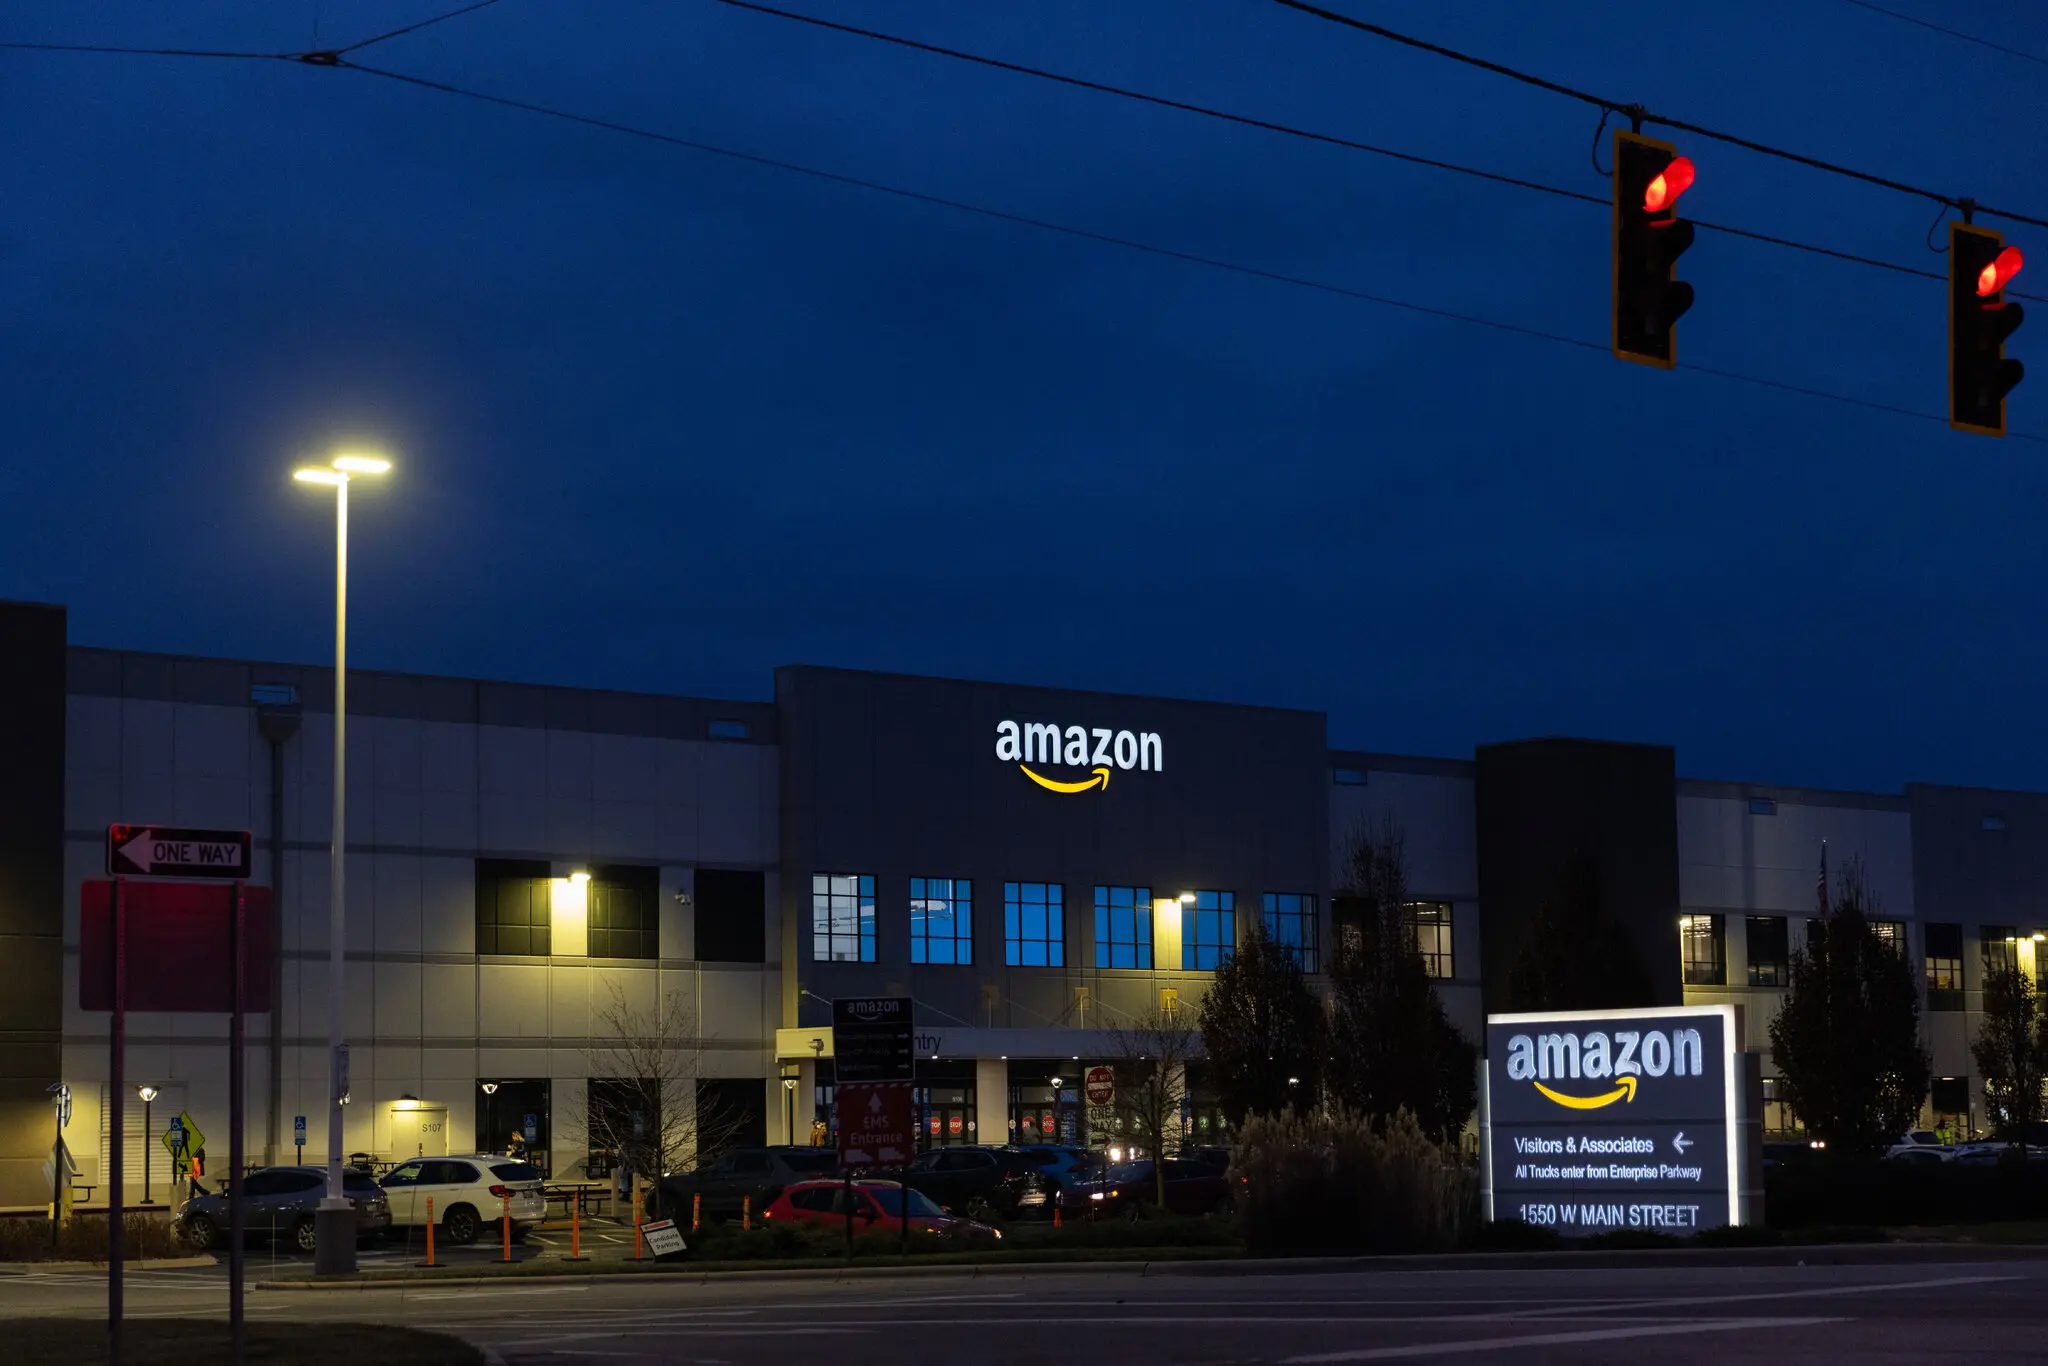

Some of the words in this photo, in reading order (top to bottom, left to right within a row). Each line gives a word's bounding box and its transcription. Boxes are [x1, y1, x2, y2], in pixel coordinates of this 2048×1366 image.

[995, 719, 1163, 772] amazon
[154, 842, 191, 862] ONE
[199, 843, 236, 864] WAY
[847, 1000, 899, 1014] amazon
[914, 1032, 942, 1055] ntry
[1507, 1028, 1702, 1080] amazon
[1091, 1107, 1111, 1119] ONE
[422, 1123, 441, 1133] S107
[863, 1115, 890, 1130] EMS
[850, 1131, 903, 1146] Entrance
[1514, 1136, 1563, 1154] Visitors
[1566, 1137, 1577, 1154] &
[1580, 1136, 1654, 1154] Associates
[1515, 1164, 1527, 1178] All
[1529, 1164, 1560, 1179] Trucks
[1561, 1166, 1585, 1179] enter
[1587, 1164, 1608, 1179] from
[1610, 1164, 1658, 1182] Enterprise
[1660, 1164, 1702, 1182] Parkway
[1519, 1204, 1556, 1225] 1550
[1560, 1205, 1577, 1225] W
[1580, 1205, 1624, 1226] MAIN
[1628, 1205, 1700, 1227] STREET
[649, 1233, 678, 1243] Candidate
[656, 1241, 680, 1249] Parking
